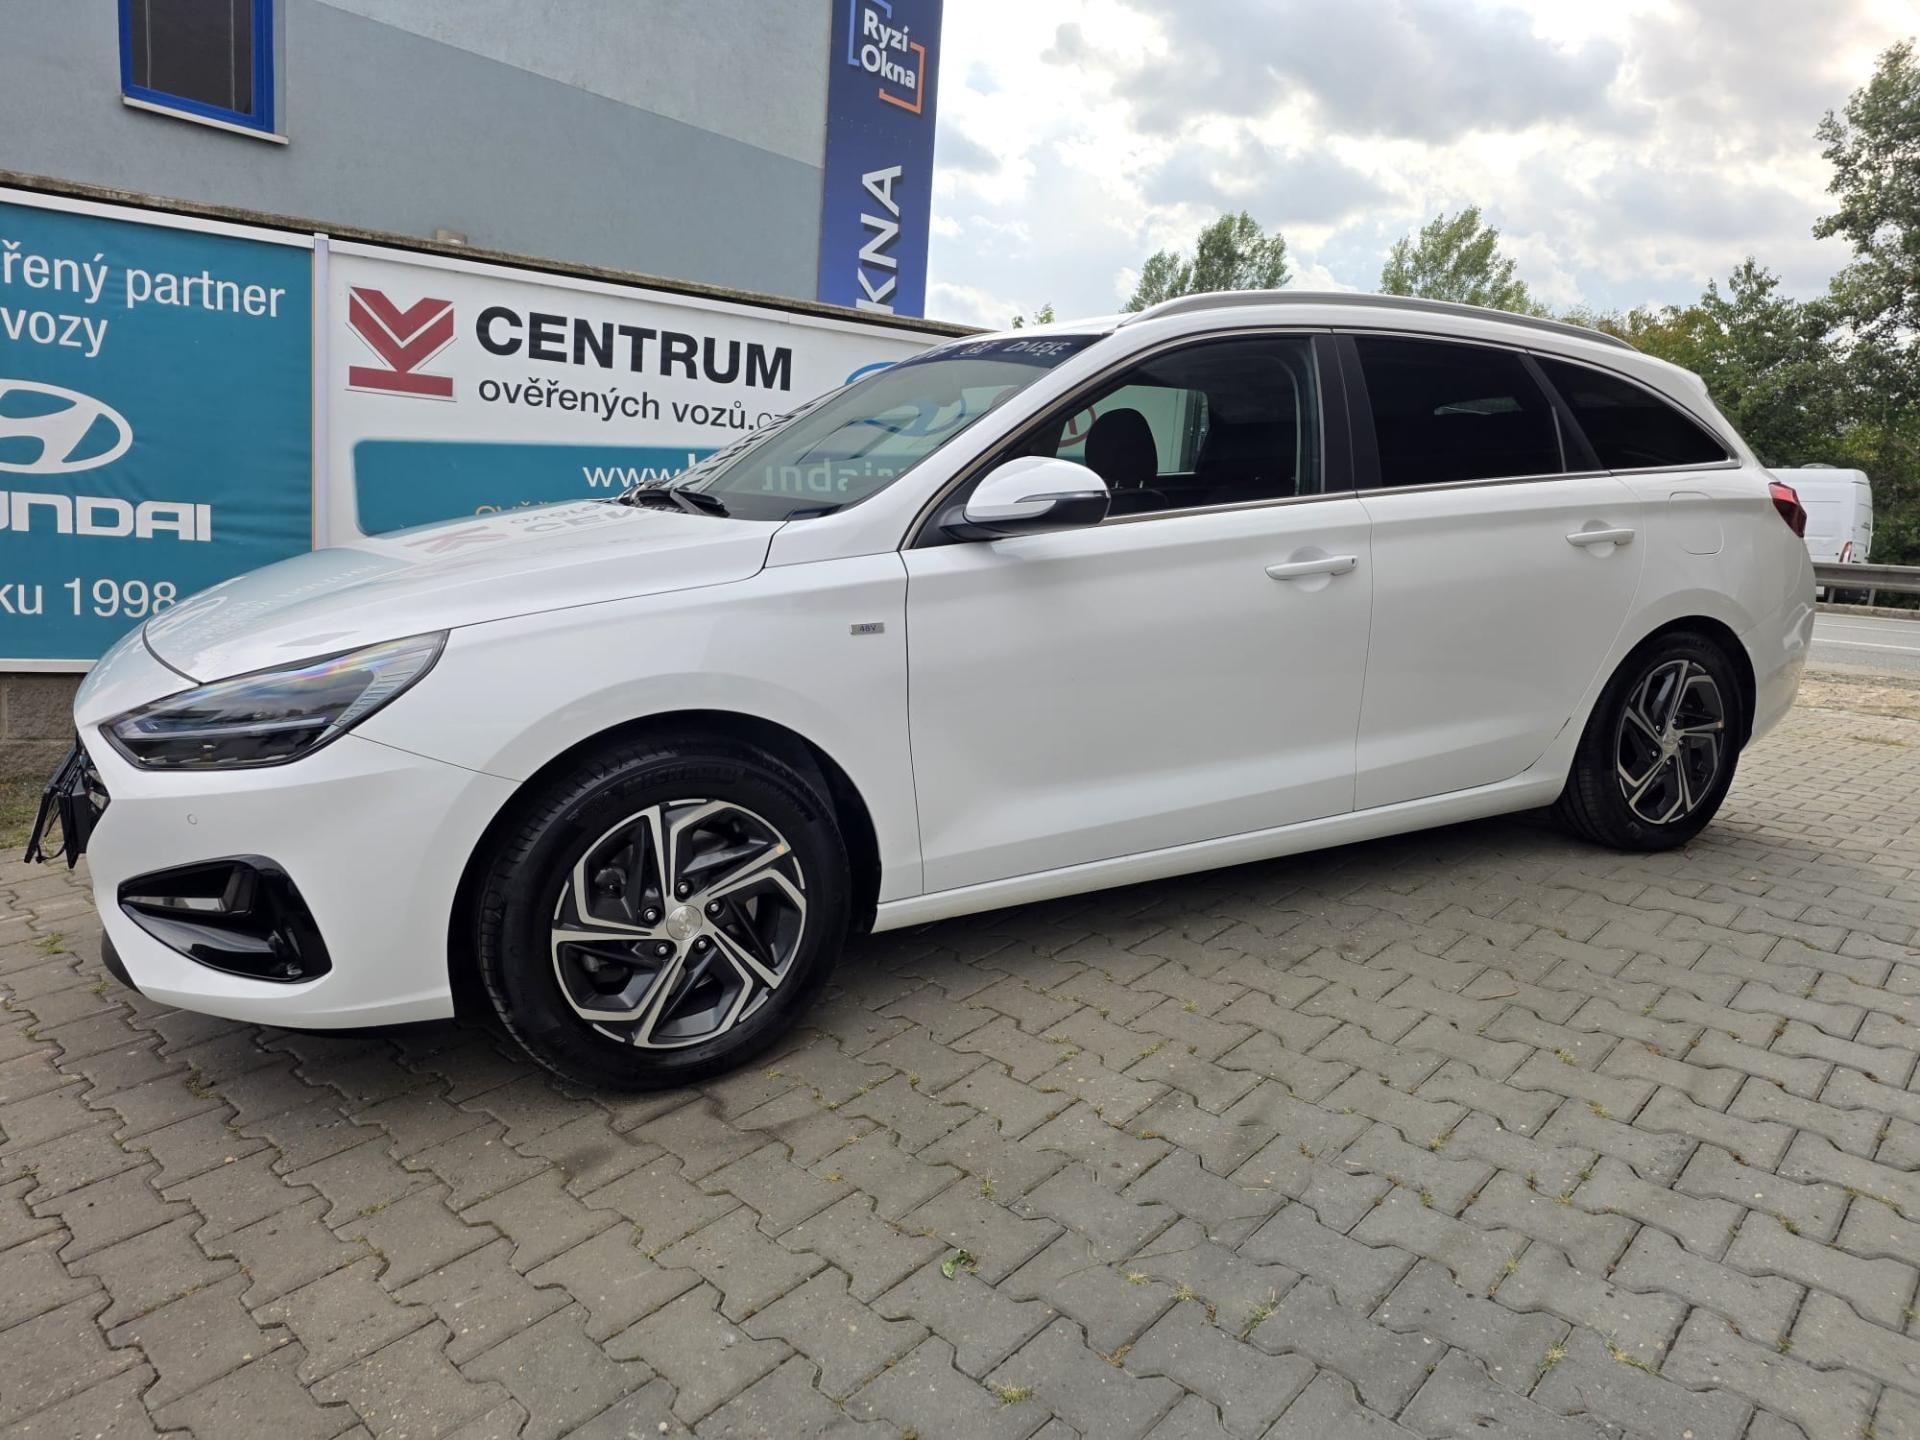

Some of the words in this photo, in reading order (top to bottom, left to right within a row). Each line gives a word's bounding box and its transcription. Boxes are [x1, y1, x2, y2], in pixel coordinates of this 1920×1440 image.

[862, 8, 909, 52] Ryzí
[861, 44, 916, 89] Okna
[126, 267, 286, 317] partner
[0, 306, 108, 358] vozy
[475, 306, 792, 391] CENTRUM
[478, 376, 660, 421] ověřených
[0, 490, 212, 542] NDAI
[63, 577, 176, 618] 1998
